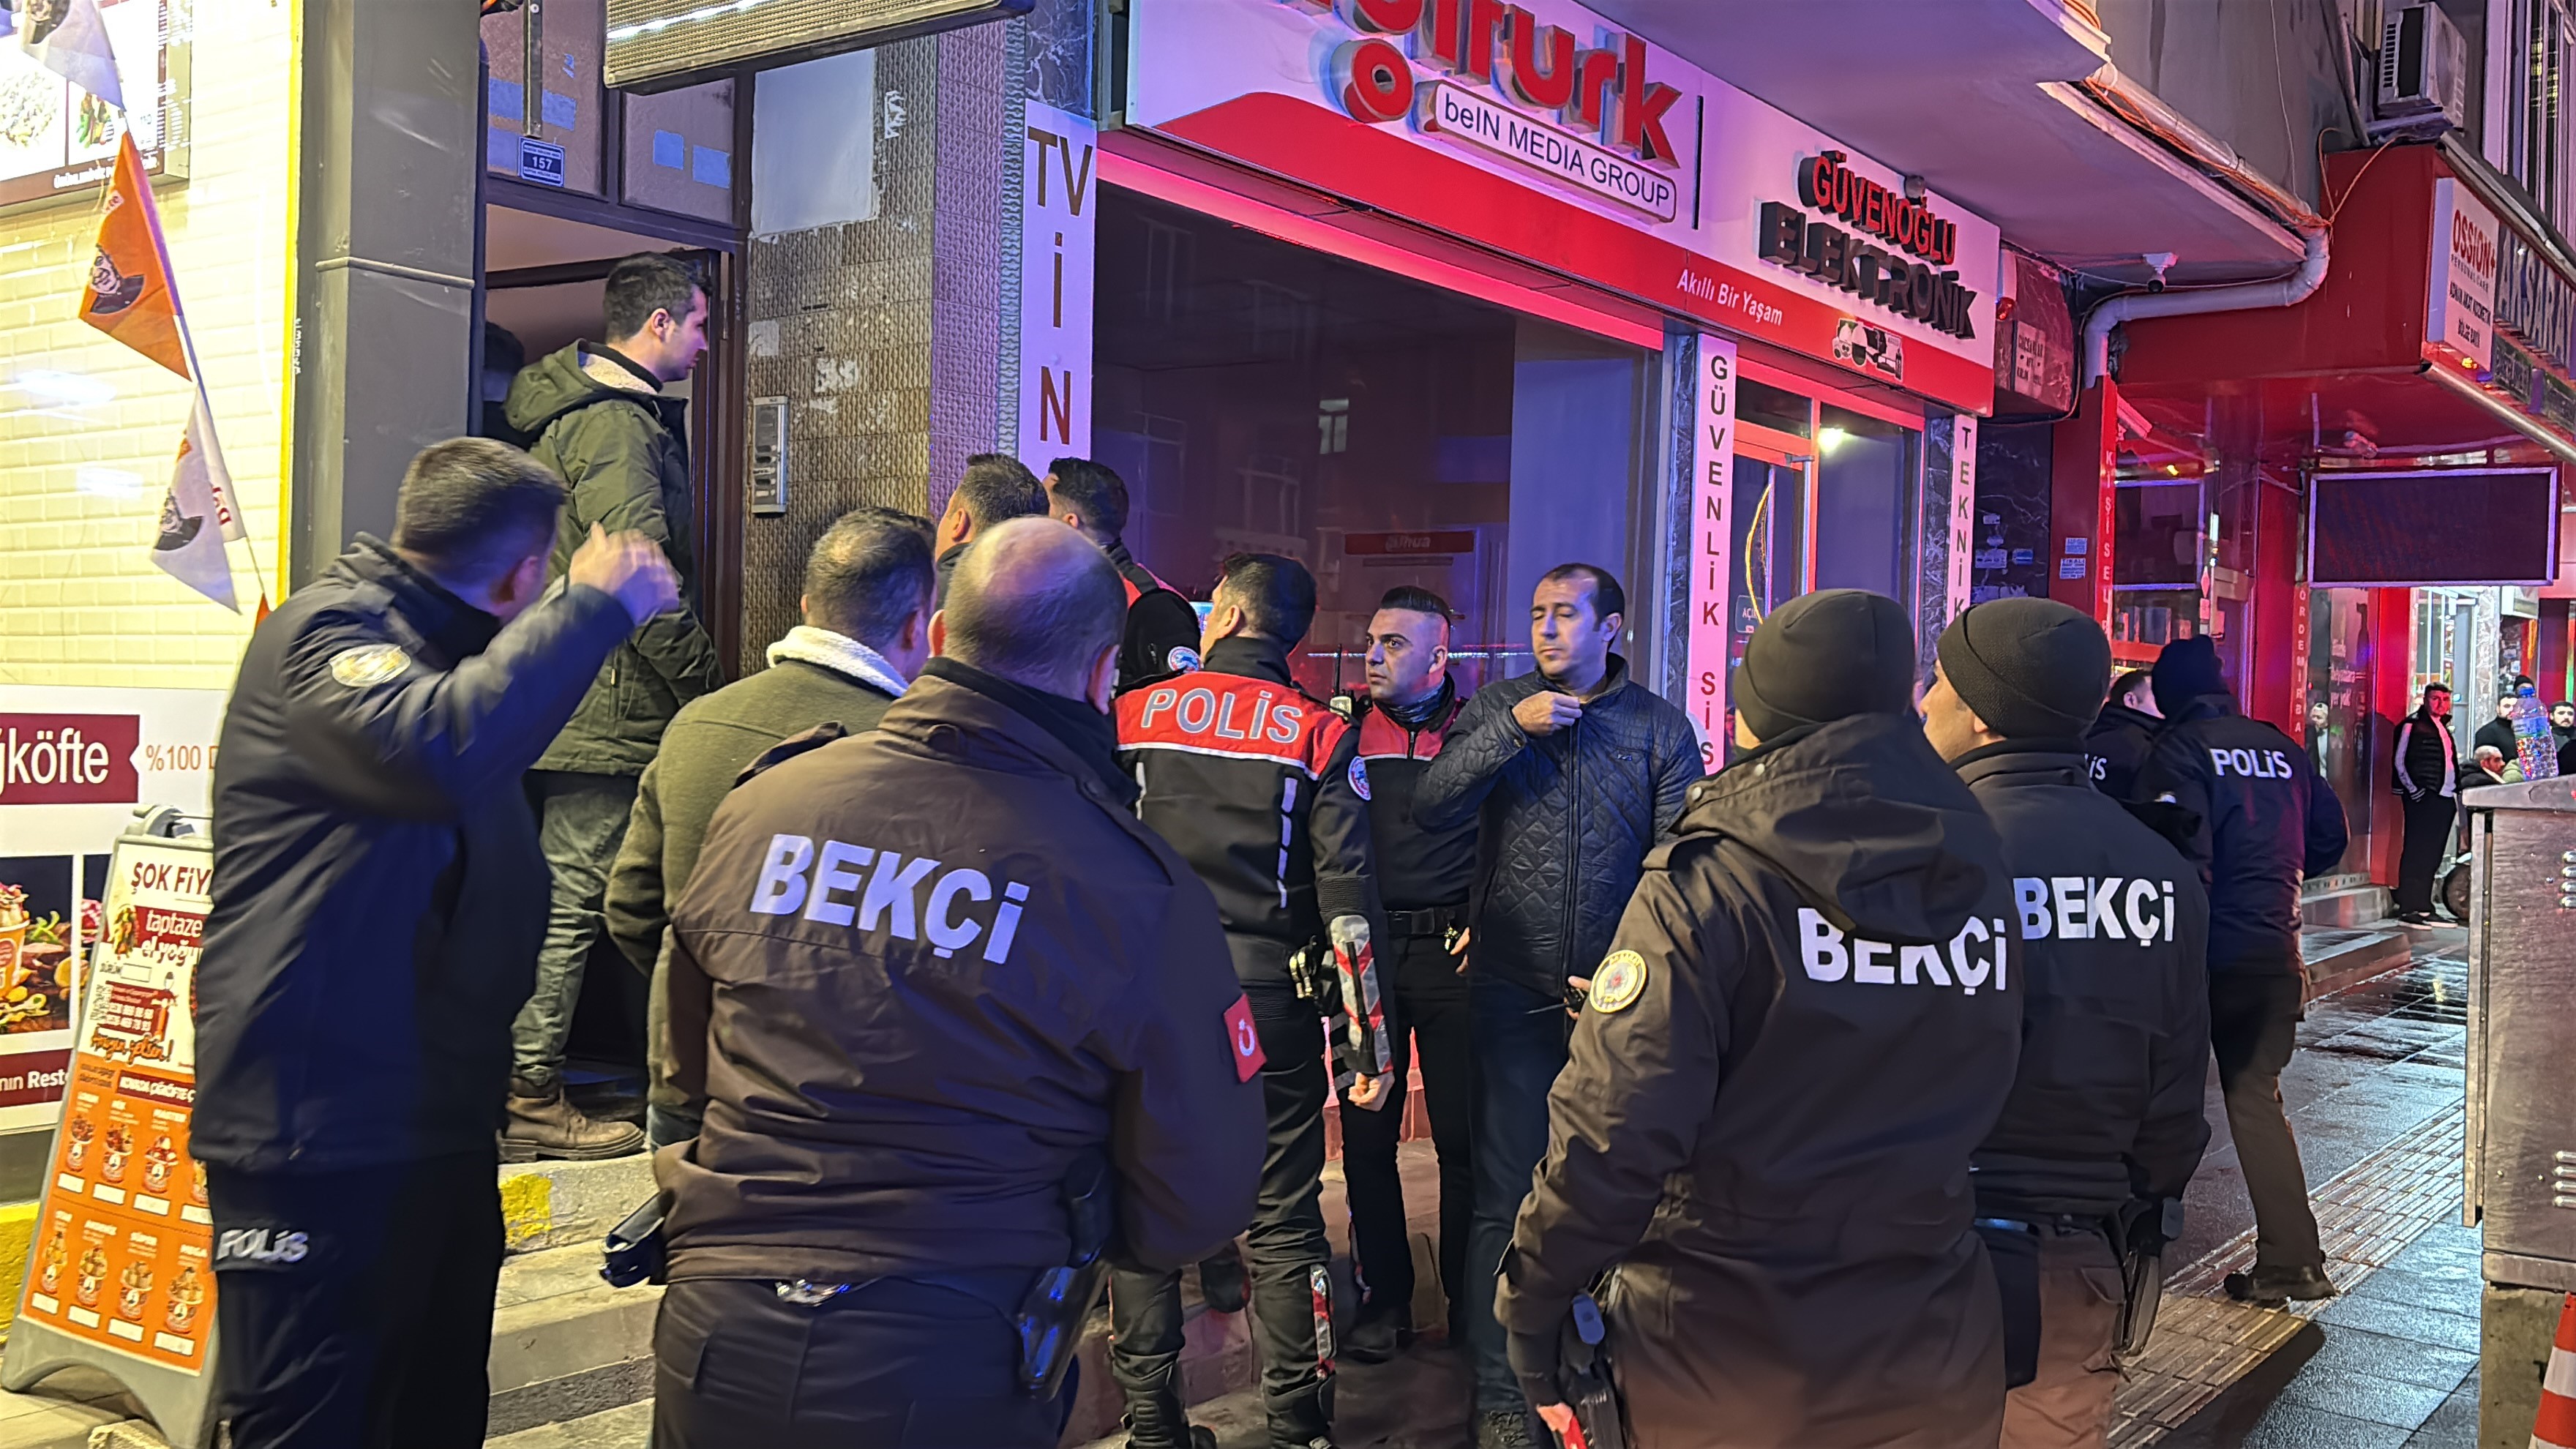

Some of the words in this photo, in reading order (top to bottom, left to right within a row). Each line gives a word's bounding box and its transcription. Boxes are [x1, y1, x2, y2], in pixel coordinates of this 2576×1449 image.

[532, 156, 553, 171] 157
[1027, 125, 1093, 217] TV
[1444, 93, 1500, 141] beIN
[1508, 120, 1585, 177] MEDIA
[1590, 157, 1671, 208] GROUP
[1811, 150, 1956, 266] GÜVENOĞLU
[1677, 269, 1715, 302] Akıllı
[1717, 282, 1740, 309] Bir
[1742, 291, 1783, 326] Yaşam
[1702, 355, 1729, 627] GÜVENLİK
[1954, 426, 1972, 617] TEKNİK
[1140, 687, 1303, 744] POLİS
[146, 744, 202, 771] %100
[130, 861, 173, 895] ŞOK
[173, 866, 212, 896] FİY
[141, 936, 158, 959] el
[146, 910, 203, 937] taptaze
